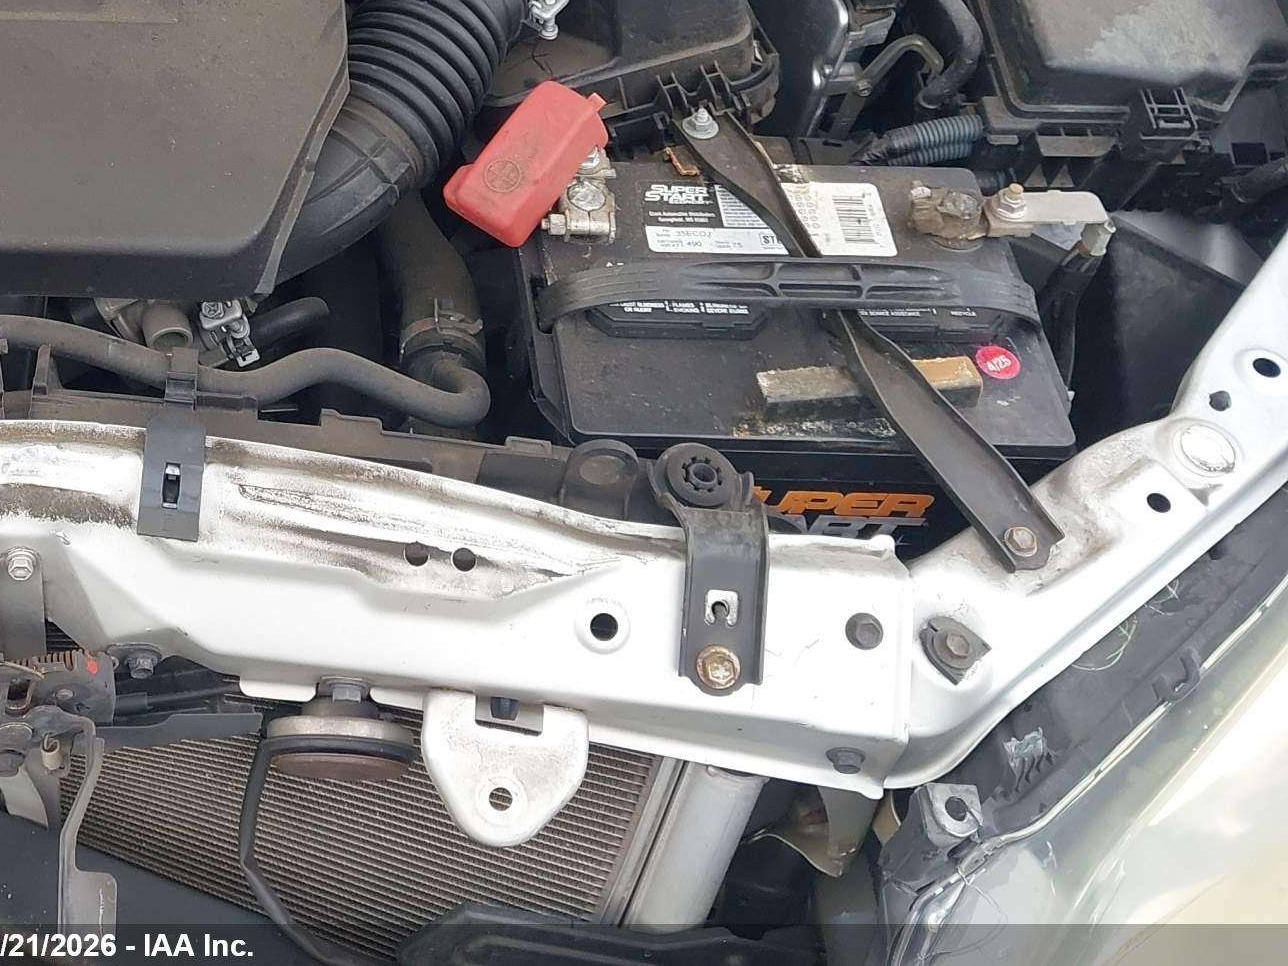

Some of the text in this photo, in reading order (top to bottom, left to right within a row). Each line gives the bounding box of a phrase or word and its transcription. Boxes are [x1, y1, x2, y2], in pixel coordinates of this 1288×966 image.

[650, 184, 708, 194] SUPER
[644, 191, 710, 202] START
[986, 354, 1012, 372] 4/25
